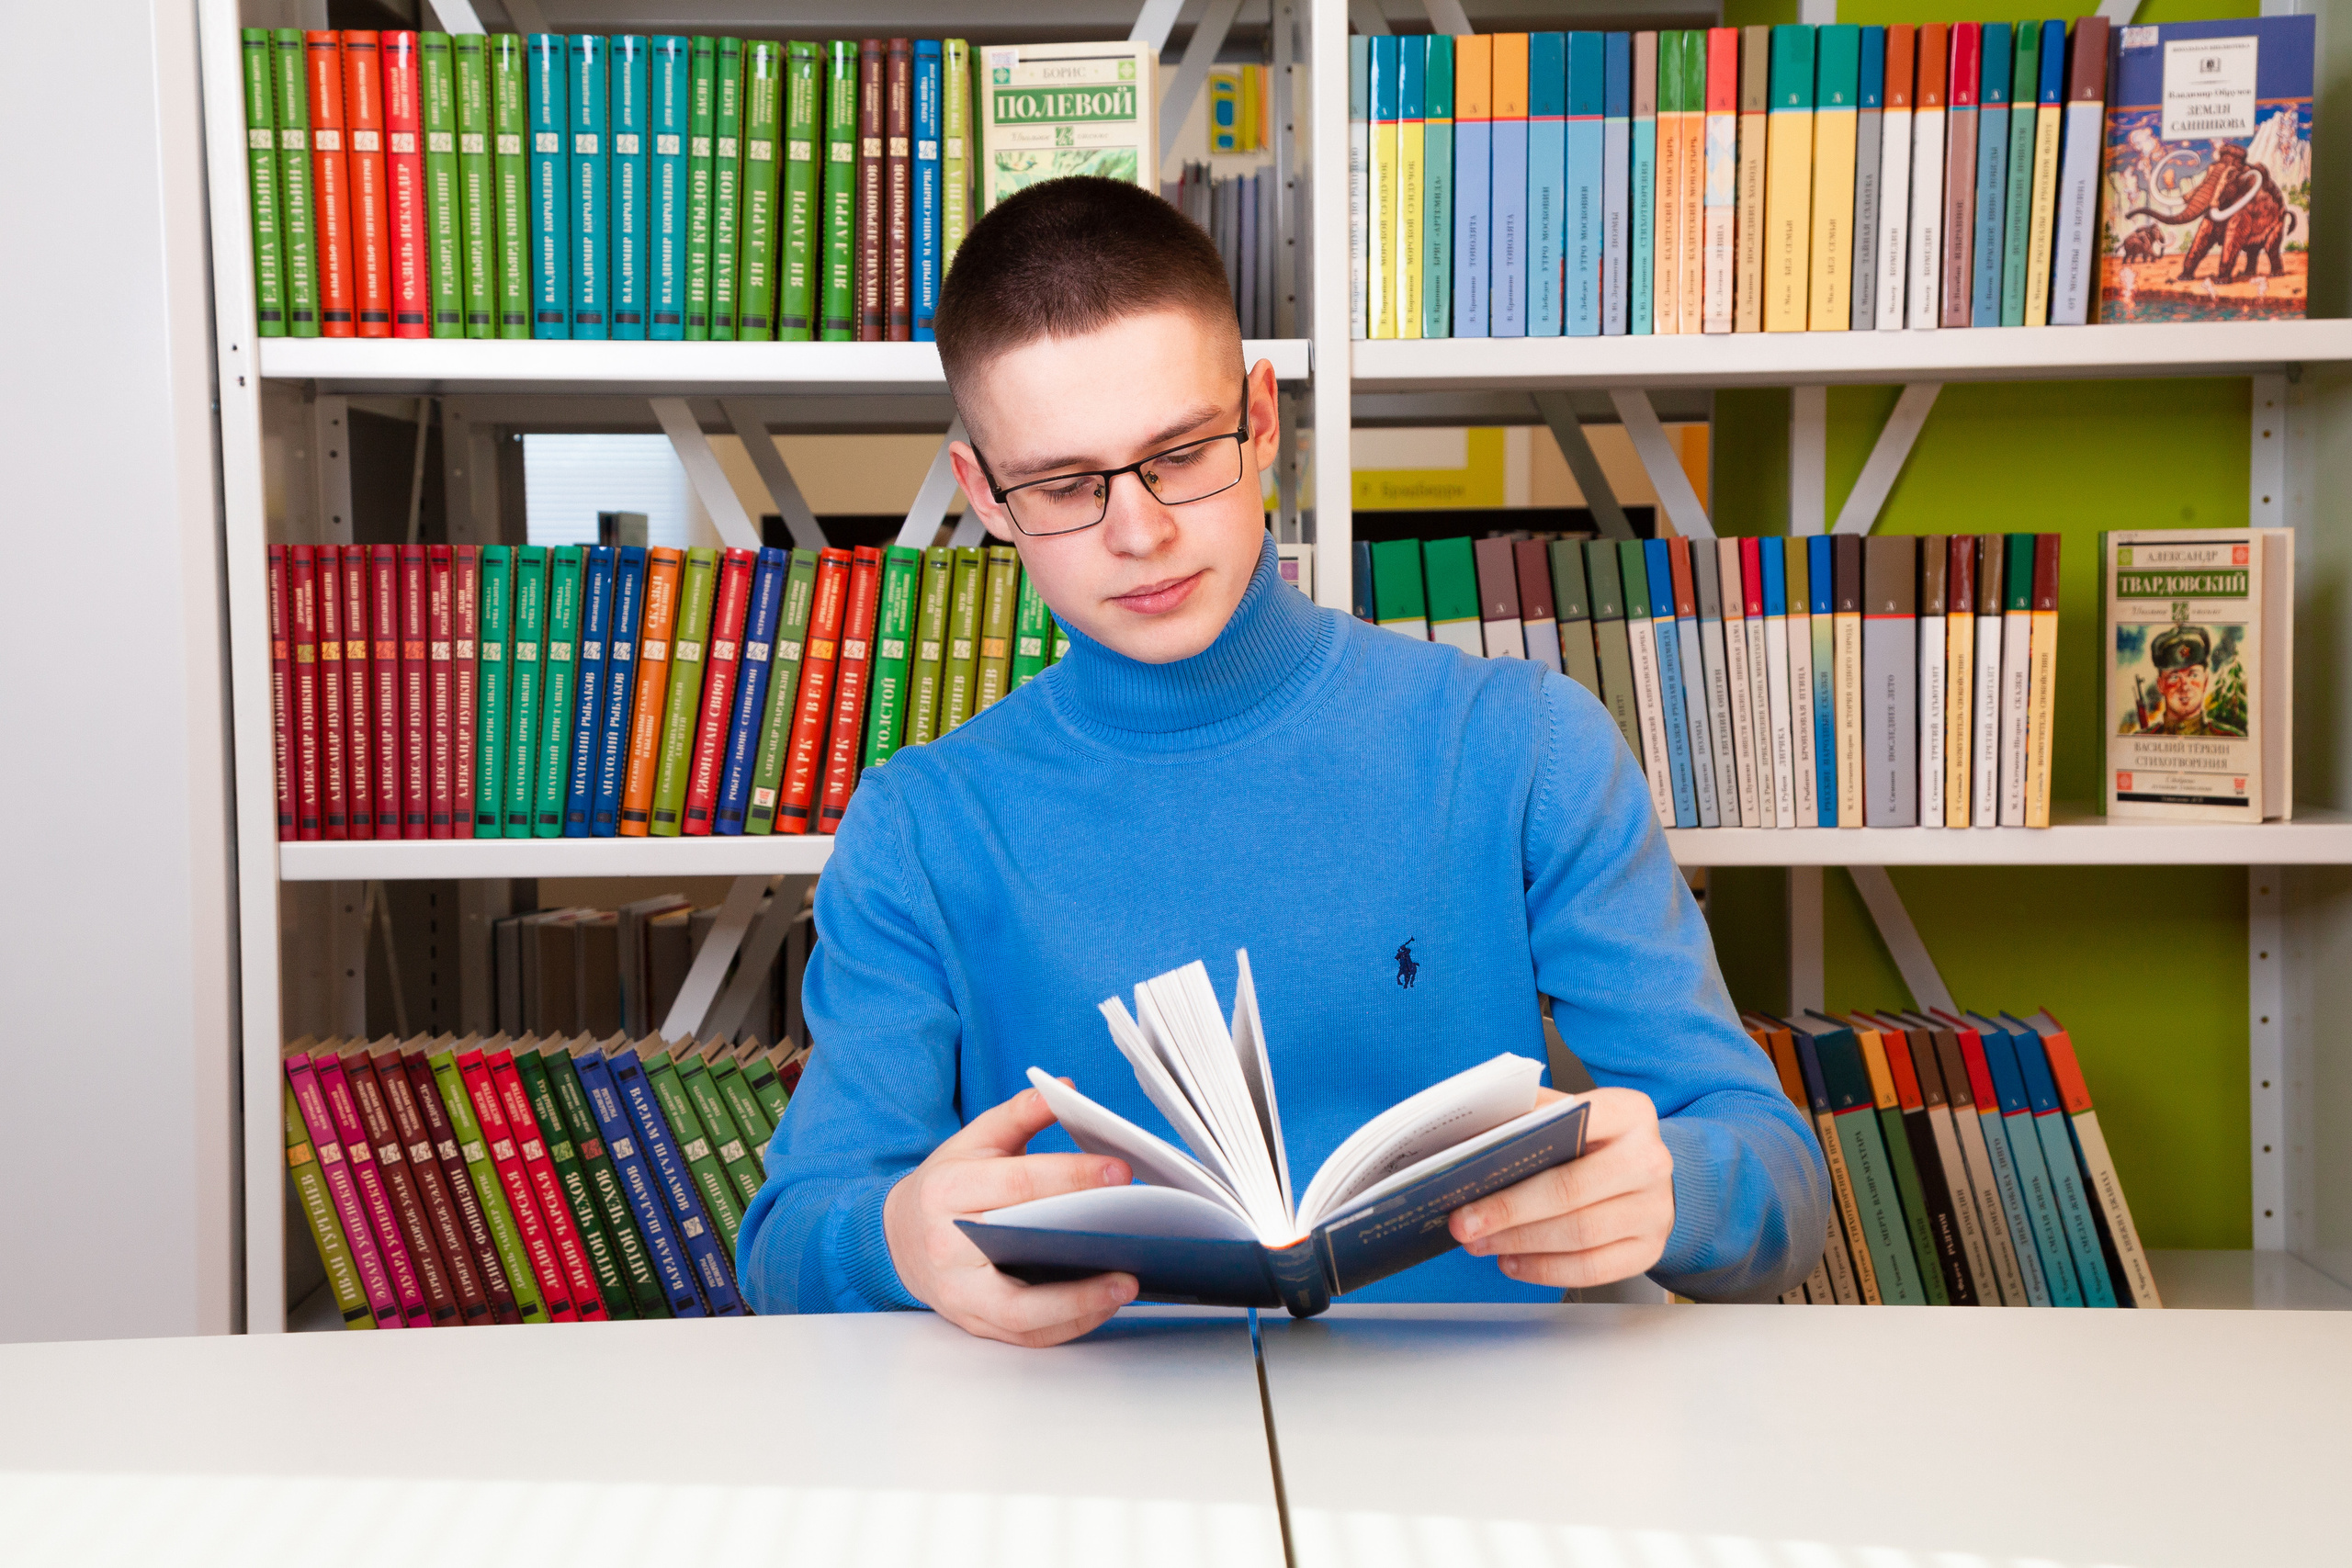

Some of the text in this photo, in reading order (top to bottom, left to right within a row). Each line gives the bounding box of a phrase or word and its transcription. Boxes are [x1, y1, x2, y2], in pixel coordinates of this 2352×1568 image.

[697, 78, 707, 115] БАСНИ
[723, 79, 734, 116] БАСНИ
[996, 85, 1134, 119] ПОЛЕВОЙ
[1043, 67, 1087, 79] БОРИС
[255, 156, 277, 302] ЕЛЕНА ИЛЬИНА
[288, 156, 309, 303] ЕЛЕНА ИЛЬИНА
[398, 164, 414, 299] ФАЗИЛЬ ИСКАНДЕР
[437, 170, 454, 294] РЕДЬЯРД КИПЛИНГ
[469, 174, 485, 296] РЕДЬЯРД КИПЛИНГ
[504, 174, 520, 296] РЕДЬЯРД КИПЛИНГ
[543, 162, 556, 302] ВЛАДИМИР КОРОЛЕНКО
[582, 163, 594, 303] ВЛАДИМИР КОРОЛЕНКО
[623, 163, 634, 303] ВЛАДИМИР КОРОЛЕНКО
[662, 164, 673, 303] ВЛАДИМИР КОРОЛЕНКО
[692, 170, 707, 301] ИВАН КРЫЛОВ
[718, 171, 733, 302] ИВАН КРЫЛОВ
[751, 190, 766, 287] ЯН ЛАРРИ
[791, 190, 807, 288] ЯН ЛАРРИ
[834, 192, 849, 288] ЯН ЛАРРИ
[866, 164, 878, 307] МИХАИЛ ЛЕРМОНТОВ
[894, 164, 906, 307] МИХАИЛ ЛЕРМОНТОВ
[922, 168, 933, 309] ДМИТРИЙ МАМИН-СИБИРЯК
[949, 170, 963, 239] ОЛЕША
[650, 576, 662, 628] СКАЗКИ
[2119, 571, 2246, 595] ТВАРДОВСКИЙ
[2147, 550, 2219, 563] АЛЕКСАНДР
[300, 675, 315, 805] АЛЕКСАНДР ПУШКИН
[326, 673, 341, 802] АЛЕКСАНДР ПУШКИН
[352, 672, 367, 800] АЛЕКСАНДР ПУШКИН
[380, 672, 394, 800] АЛЕКСАНДР ПУШКИН
[409, 672, 423, 801] АЛЕКСАНДР ПУШКИН
[435, 672, 448, 801] АЛЕКСАНДР ПУШКИН
[459, 671, 470, 799] АЛЕКСАНДР ПУШКИН
[483, 674, 495, 802] АНАТОЛИЙ ПРИСТАВКИН
[515, 674, 530, 802] АНАТОЛИЙ ПРИСТАВКИН
[548, 674, 564, 801] АНАТОЛИЙ ПРИСТАВКИН
[575, 672, 595, 796] АНАТОЛИЙ РЫБАКОВ
[602, 672, 625, 797] АНАТОЛИЙ РЫБАКОВ
[695, 671, 726, 798] ДЖОНАТАН СВИФТ
[729, 669, 757, 800] РОБЕРТ ЛЬЮИС СТИВЕНСОН
[764, 671, 790, 778] АЛЕКСАНДР ТВАРДОВСКИЙ
[791, 673, 824, 794] МАРК ТВЕН
[830, 672, 858, 794] МАРК ТВЕН
[876, 677, 896, 750] ТОЛСТОЙ
[915, 677, 933, 746] ТУРГЕНЕВ
[2134, 740, 2185, 753] ВАСИЛИЙ
[2134, 755, 2228, 769] СТИХОТВОРЕНИЯ
[419, 1082, 441, 1127] НЕДОРОСЛЬ
[628, 1086, 691, 1211] ВАРЛАМ ШАЛАМОВ
[300, 1173, 356, 1301] ИВАН ТУРГЕНЕВ
[331, 1168, 388, 1300] ЭДУАРД УСПЕНСКИЙ
[360, 1168, 416, 1299] ЭДУАРД УСПЕНСКИЙ
[403, 1207, 430, 1255] ДЖОРДЖ
[435, 1205, 461, 1252] ДЖОРДЖ
[450, 1168, 508, 1294] ДЕНИС ФОНВИЗИН
[507, 1170, 560, 1290] ЛИДИЯ ЧАРСКАЯ
[536, 1169, 589, 1290] ЛИДИЯ ЧАРСКАЯ
[562, 1170, 620, 1290] АНТОН ЧЕХОВ
[594, 1168, 651, 1286] АНТОН ЧЕХОВ
[625, 1164, 684, 1290] ВАРЛАМ ШАЛАМОВ
[701, 1169, 737, 1230] ШЕКСПИР
[1938, 1212, 1956, 1255] РАЗГРОМ
[421, 1256, 444, 1299] ГЕРБЕРТ
[452, 1254, 475, 1297] ГЕРБЕРТ
